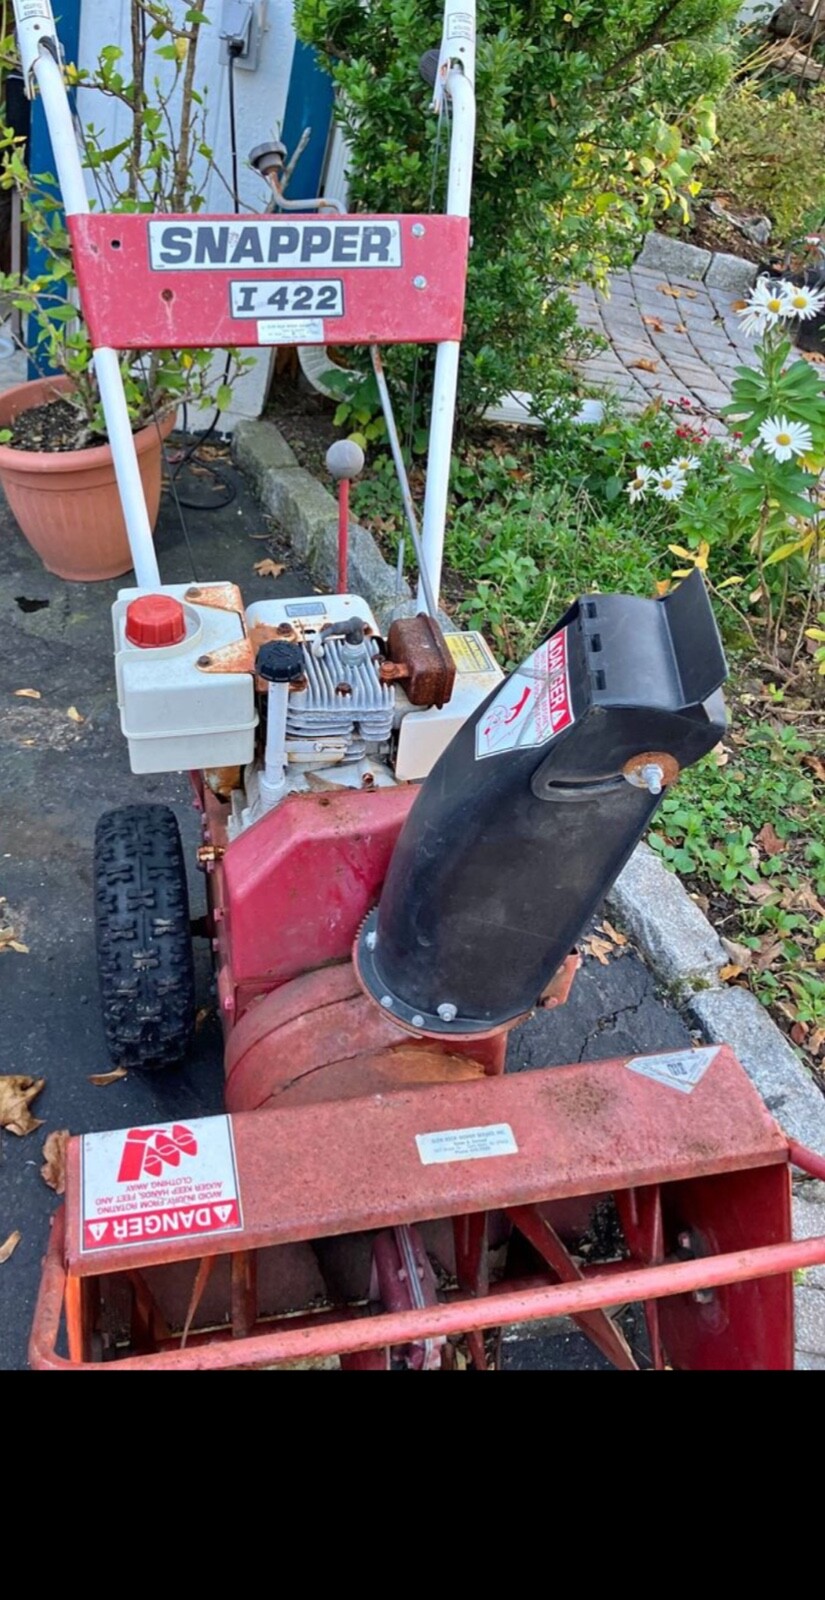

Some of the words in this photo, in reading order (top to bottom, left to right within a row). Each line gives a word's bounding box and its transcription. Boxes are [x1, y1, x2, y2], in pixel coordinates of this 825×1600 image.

[160, 226, 391, 264] SNAPPER
[236, 287, 258, 311] I
[267, 285, 338, 311] 422
[126, 1182, 149, 1191] AWAY
[150, 1176, 192, 1189] CLOTHING
[195, 1181, 223, 1191] AUGER
[171, 1185, 192, 1195] KEEP
[116, 1193, 136, 1203] FEET
[168, 1194, 196, 1204] INJURY
[197, 1191, 222, 1200] AVOID
[95, 1197, 113, 1206] AND
[140, 1199, 164, 1208] FROM
[97, 1202, 137, 1215] ROTATING
[112, 1208, 211, 1238] DANGER
